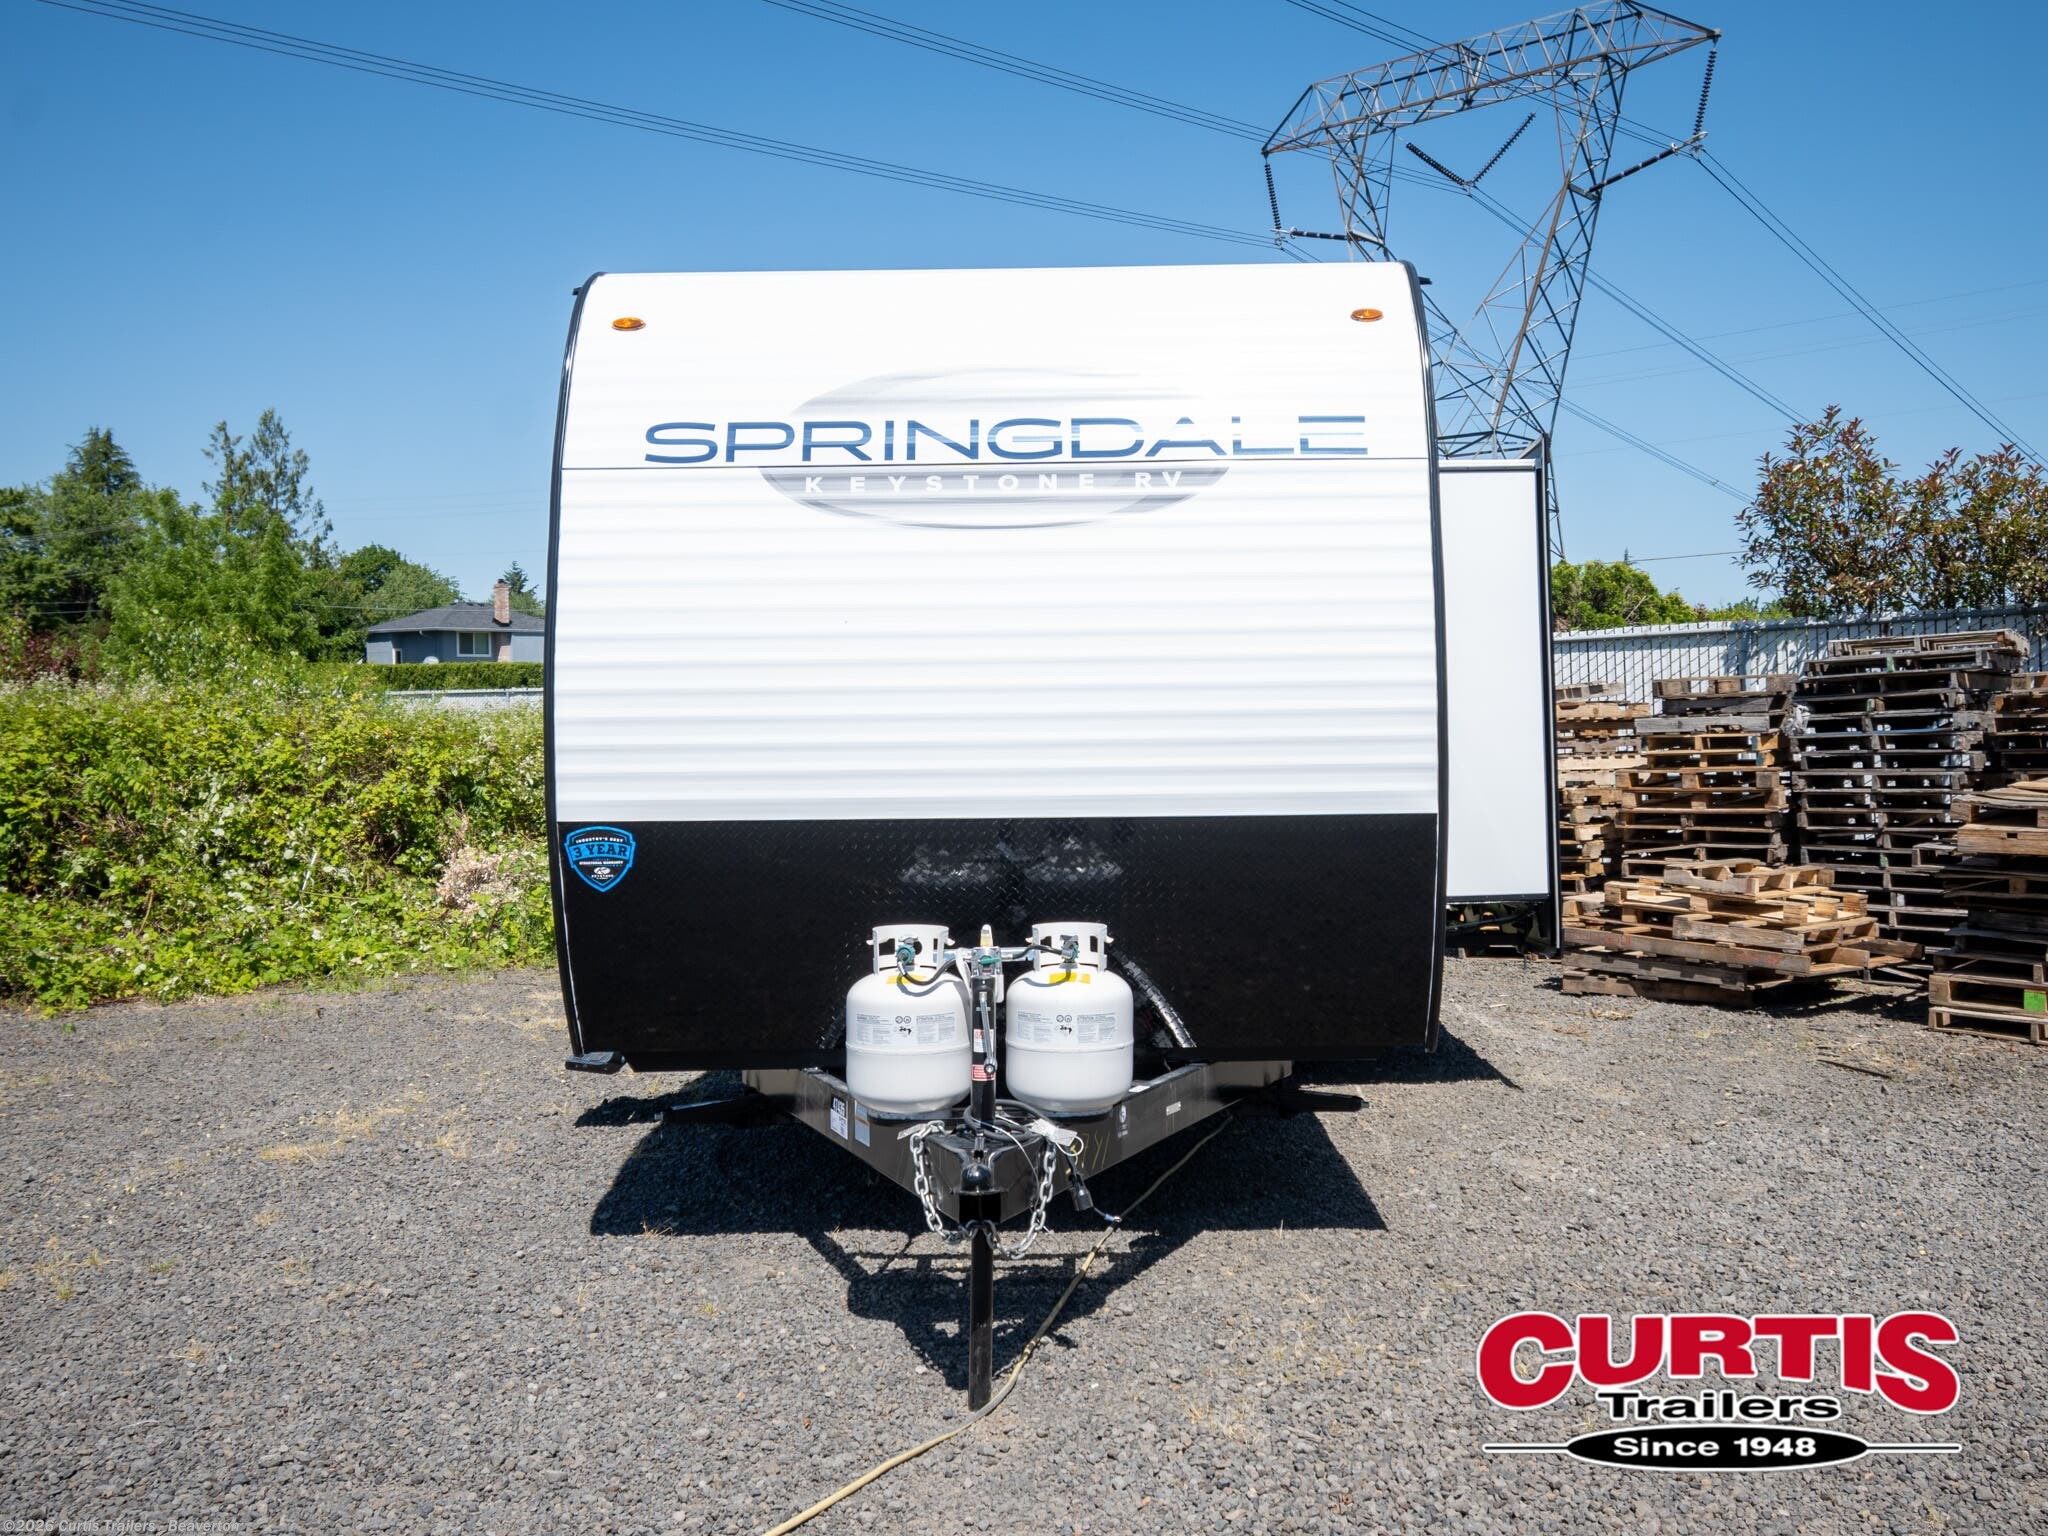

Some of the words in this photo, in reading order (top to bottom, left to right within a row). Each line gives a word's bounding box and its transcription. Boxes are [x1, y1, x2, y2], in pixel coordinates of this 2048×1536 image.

[645, 415, 1368, 464] SPRINGDALE
[804, 473, 1096, 495] KEYSTONE
[1134, 470, 1183, 489] RV
[573, 847, 582, 858] 3
[586, 844, 627, 856] YEAR
